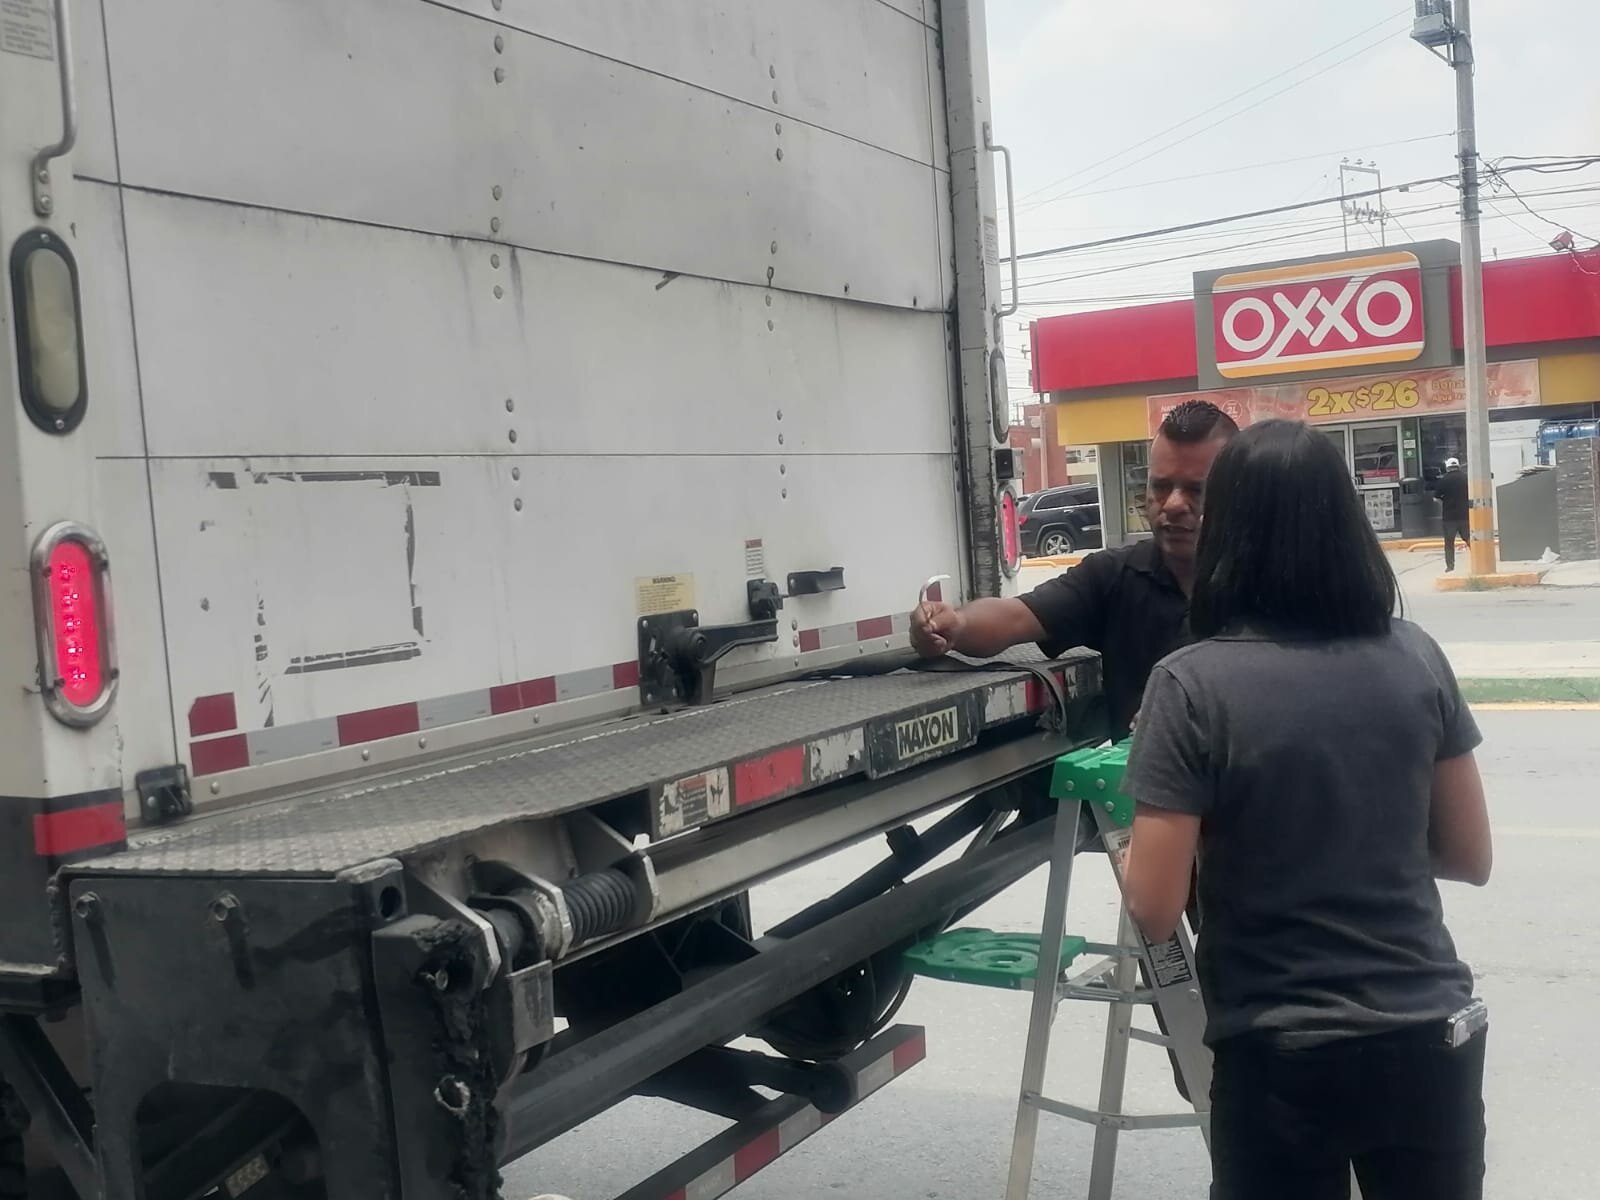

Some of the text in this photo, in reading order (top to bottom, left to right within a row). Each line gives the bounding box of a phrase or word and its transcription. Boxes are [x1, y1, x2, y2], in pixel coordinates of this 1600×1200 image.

[1222, 275, 1412, 359] OXXO
[1307, 379, 1419, 416] 2x$26
[898, 711, 954, 757] MAXON
